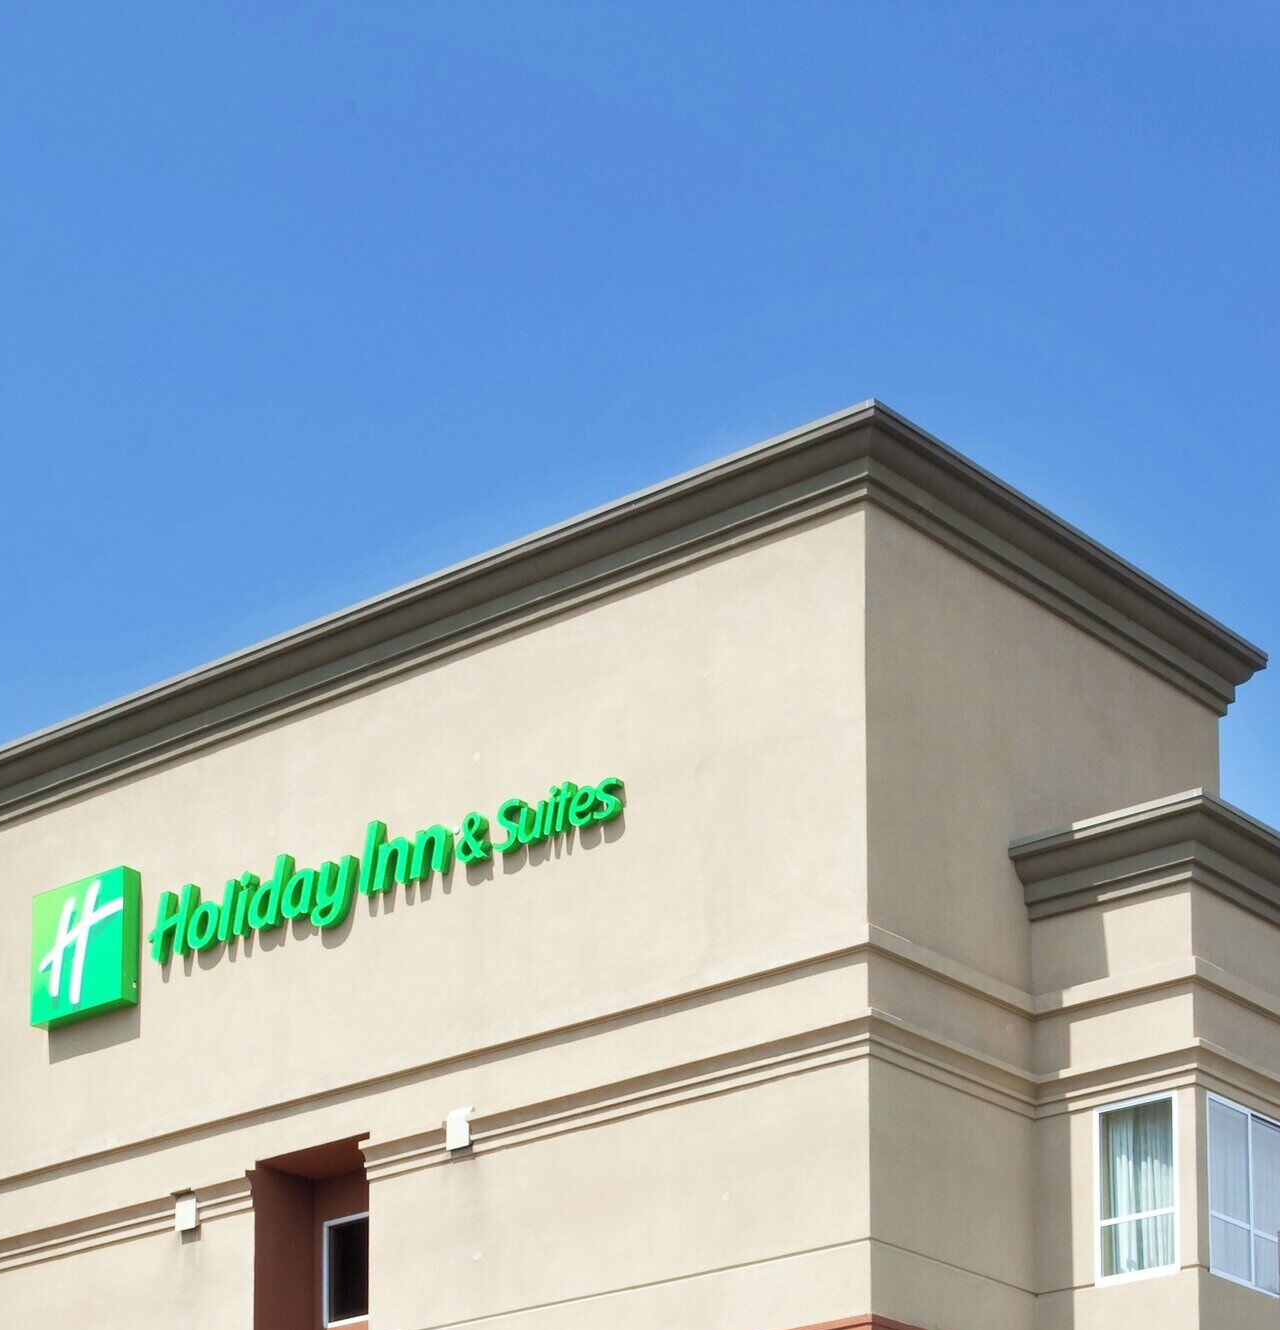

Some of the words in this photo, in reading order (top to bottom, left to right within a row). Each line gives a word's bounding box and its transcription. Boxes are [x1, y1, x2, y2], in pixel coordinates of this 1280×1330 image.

[149, 854, 360, 965] Holiday
[358, 820, 455, 897] Inn
[455, 812, 490, 865] &
[492, 777, 626, 853] Suites
